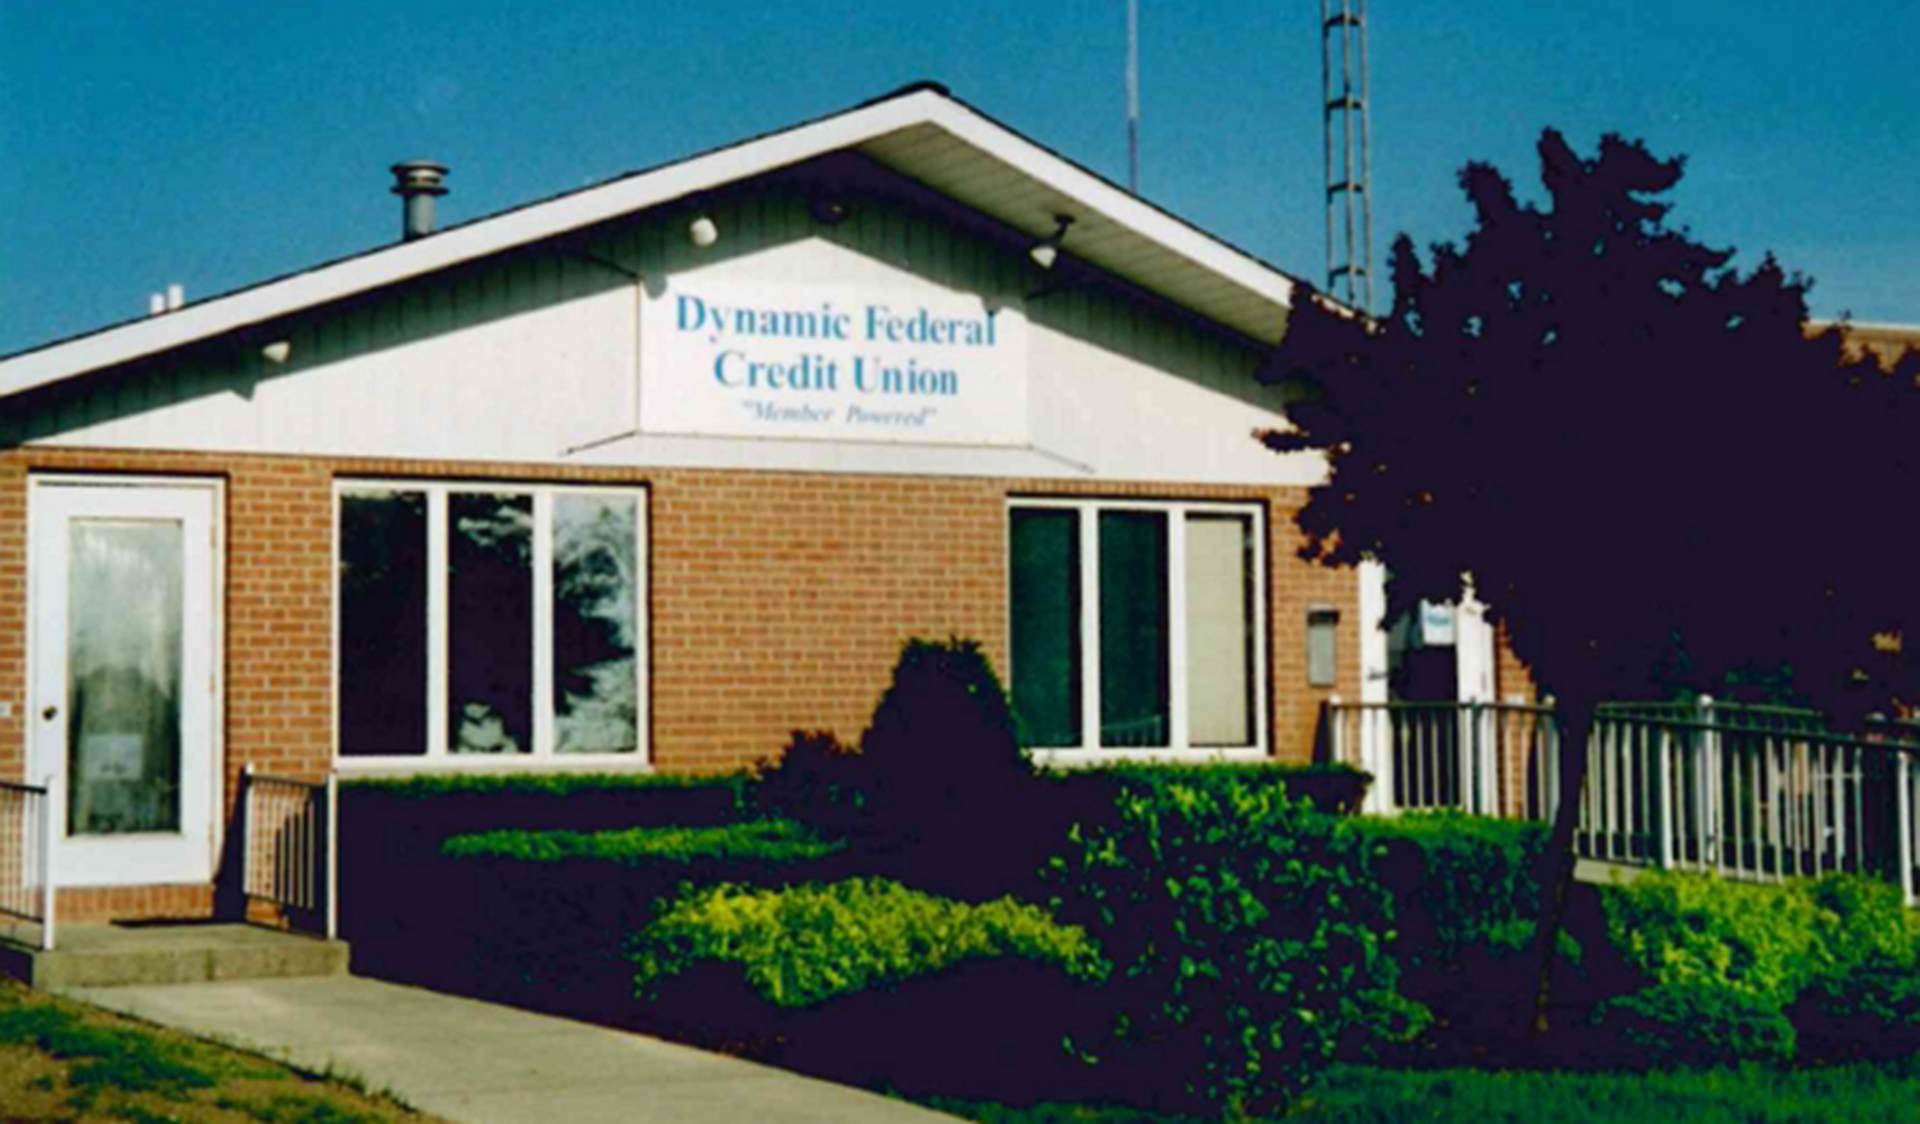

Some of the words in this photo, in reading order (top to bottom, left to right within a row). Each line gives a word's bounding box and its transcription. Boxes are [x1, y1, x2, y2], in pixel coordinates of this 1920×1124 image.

[676, 294, 851, 344] Dynamic
[865, 304, 996, 346] Federal
[714, 349, 838, 391] Credit
[853, 355, 959, 396] Union
[743, 400, 833, 423] "Member
[846, 404, 937, 427] Powered"
